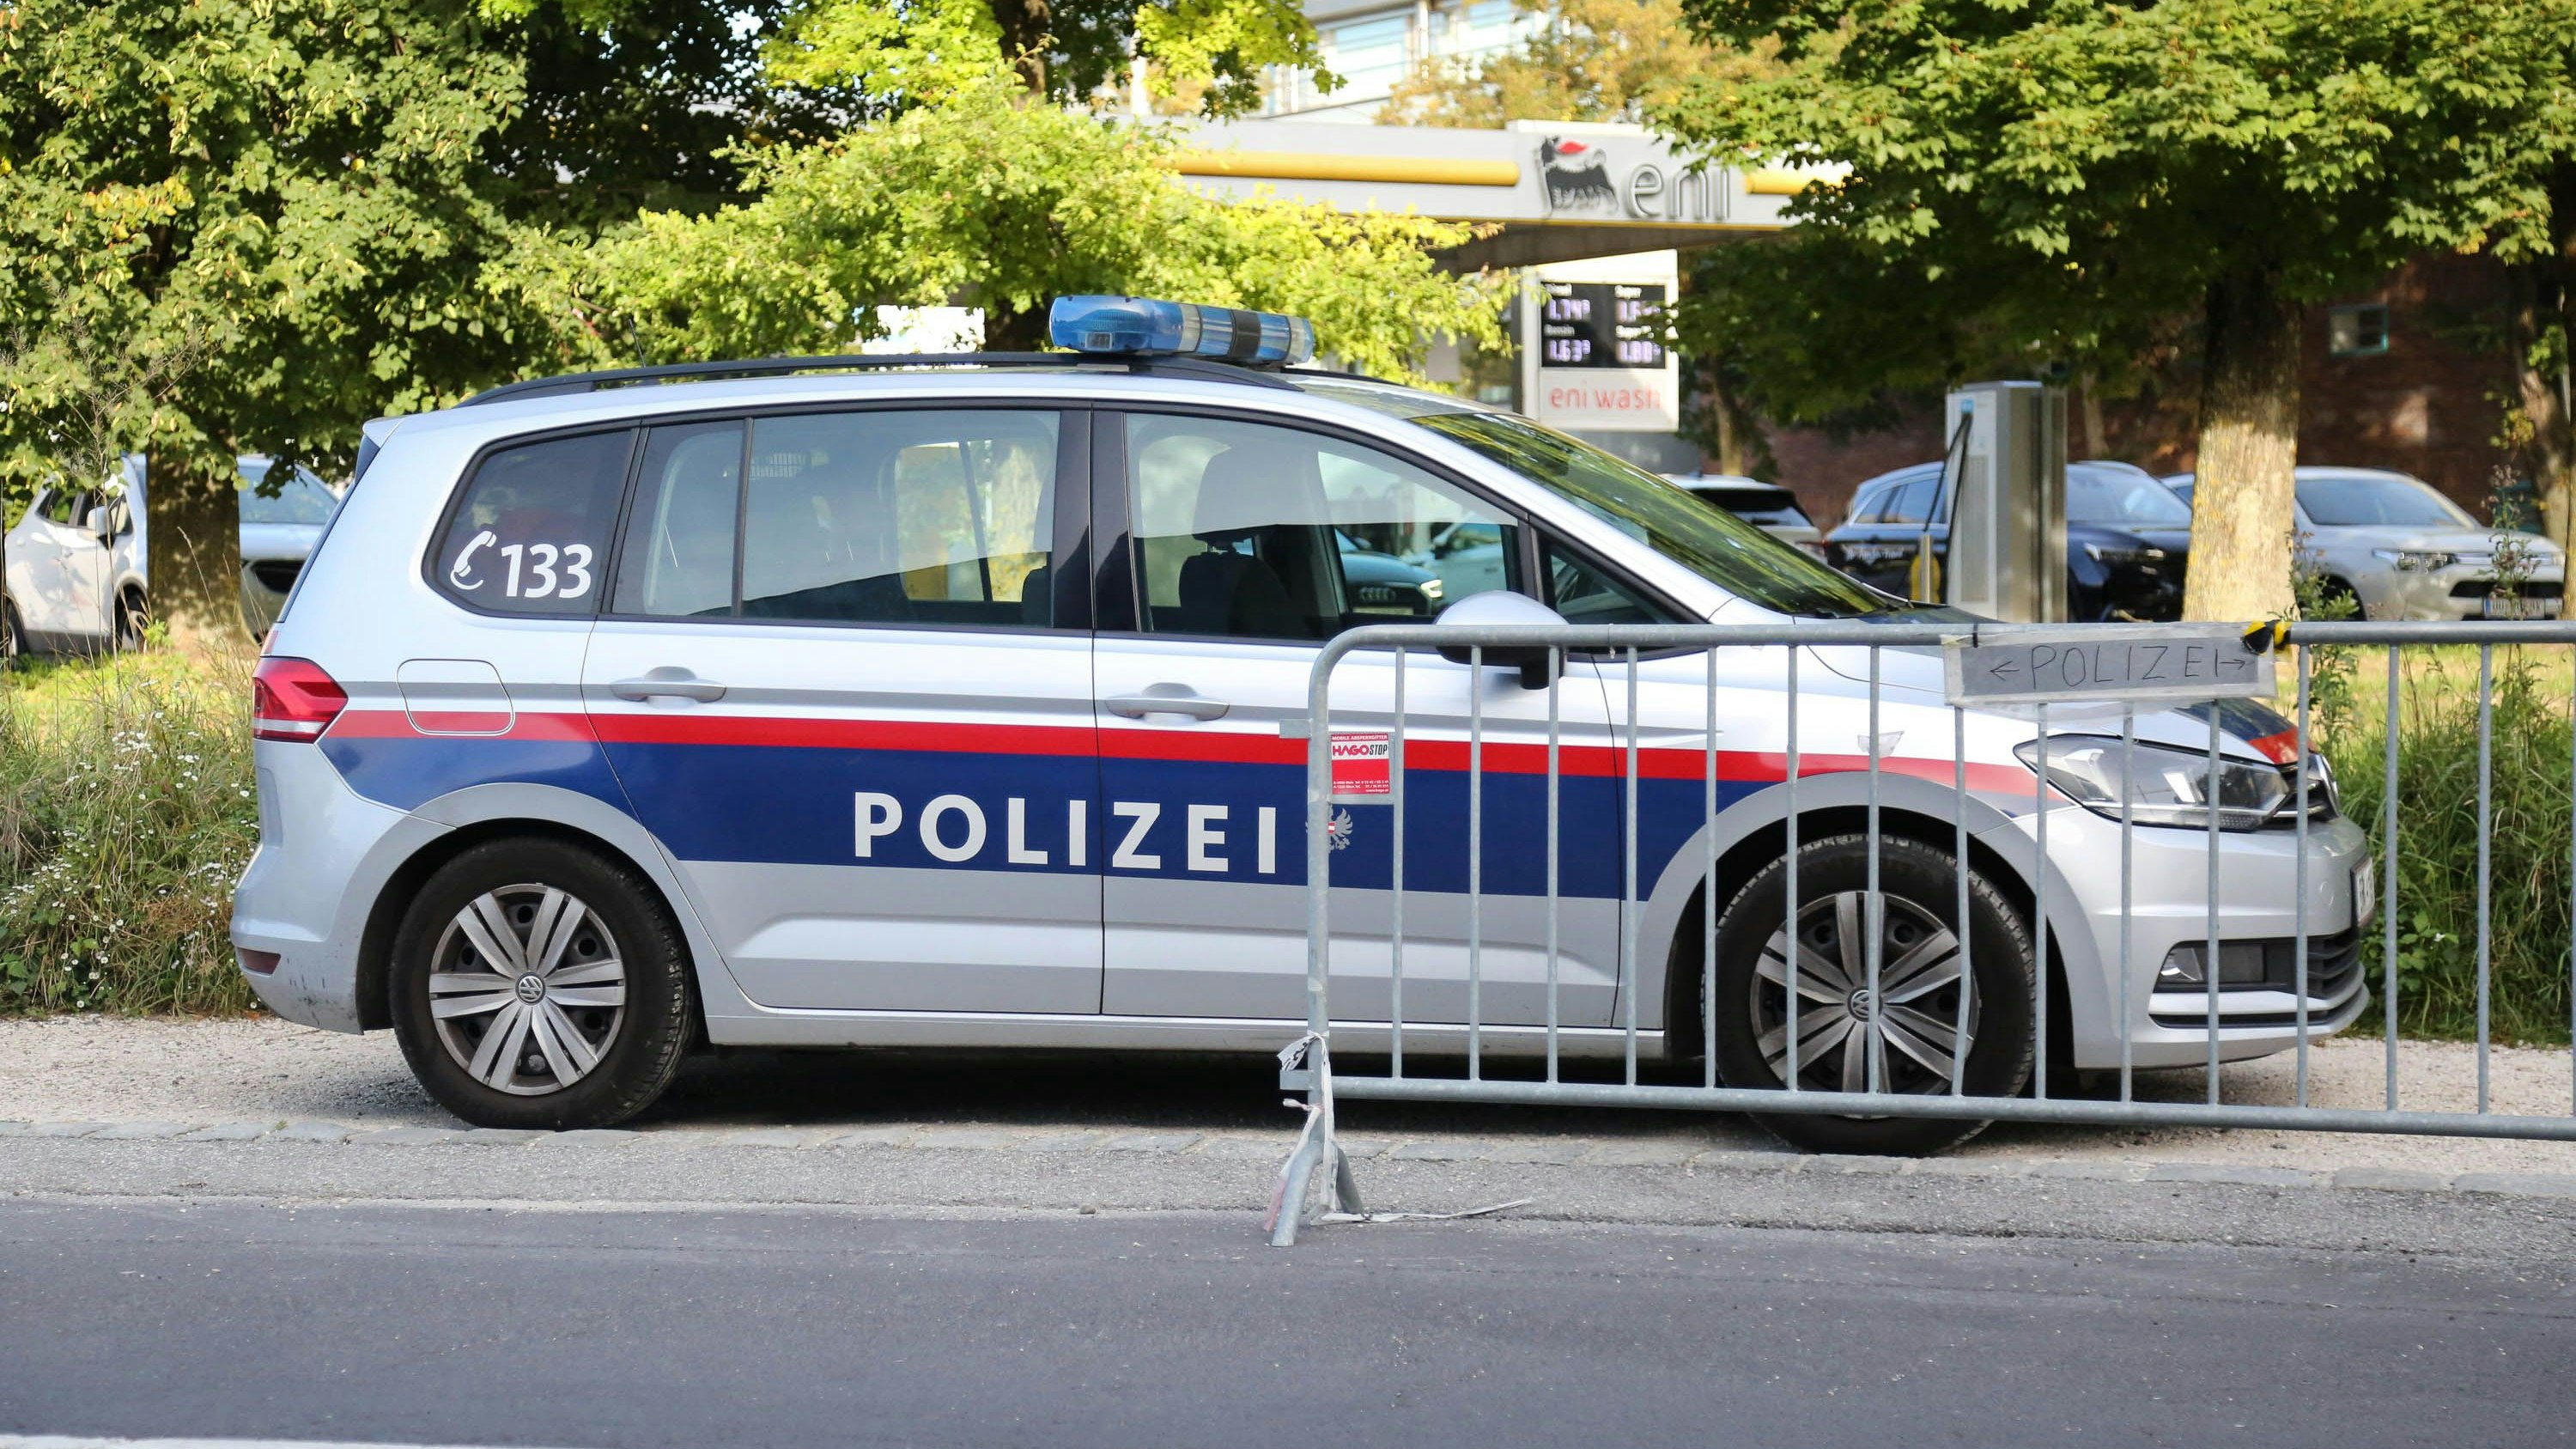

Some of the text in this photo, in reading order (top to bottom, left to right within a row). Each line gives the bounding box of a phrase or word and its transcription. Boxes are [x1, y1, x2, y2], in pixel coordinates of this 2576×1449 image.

[1626, 163, 1729, 221] eni
[1549, 379, 1662, 409] eni wash
[501, 543, 592, 599] 133
[2031, 644, 2219, 689] POLIZEI
[854, 791, 1277, 874] POLIZEI
